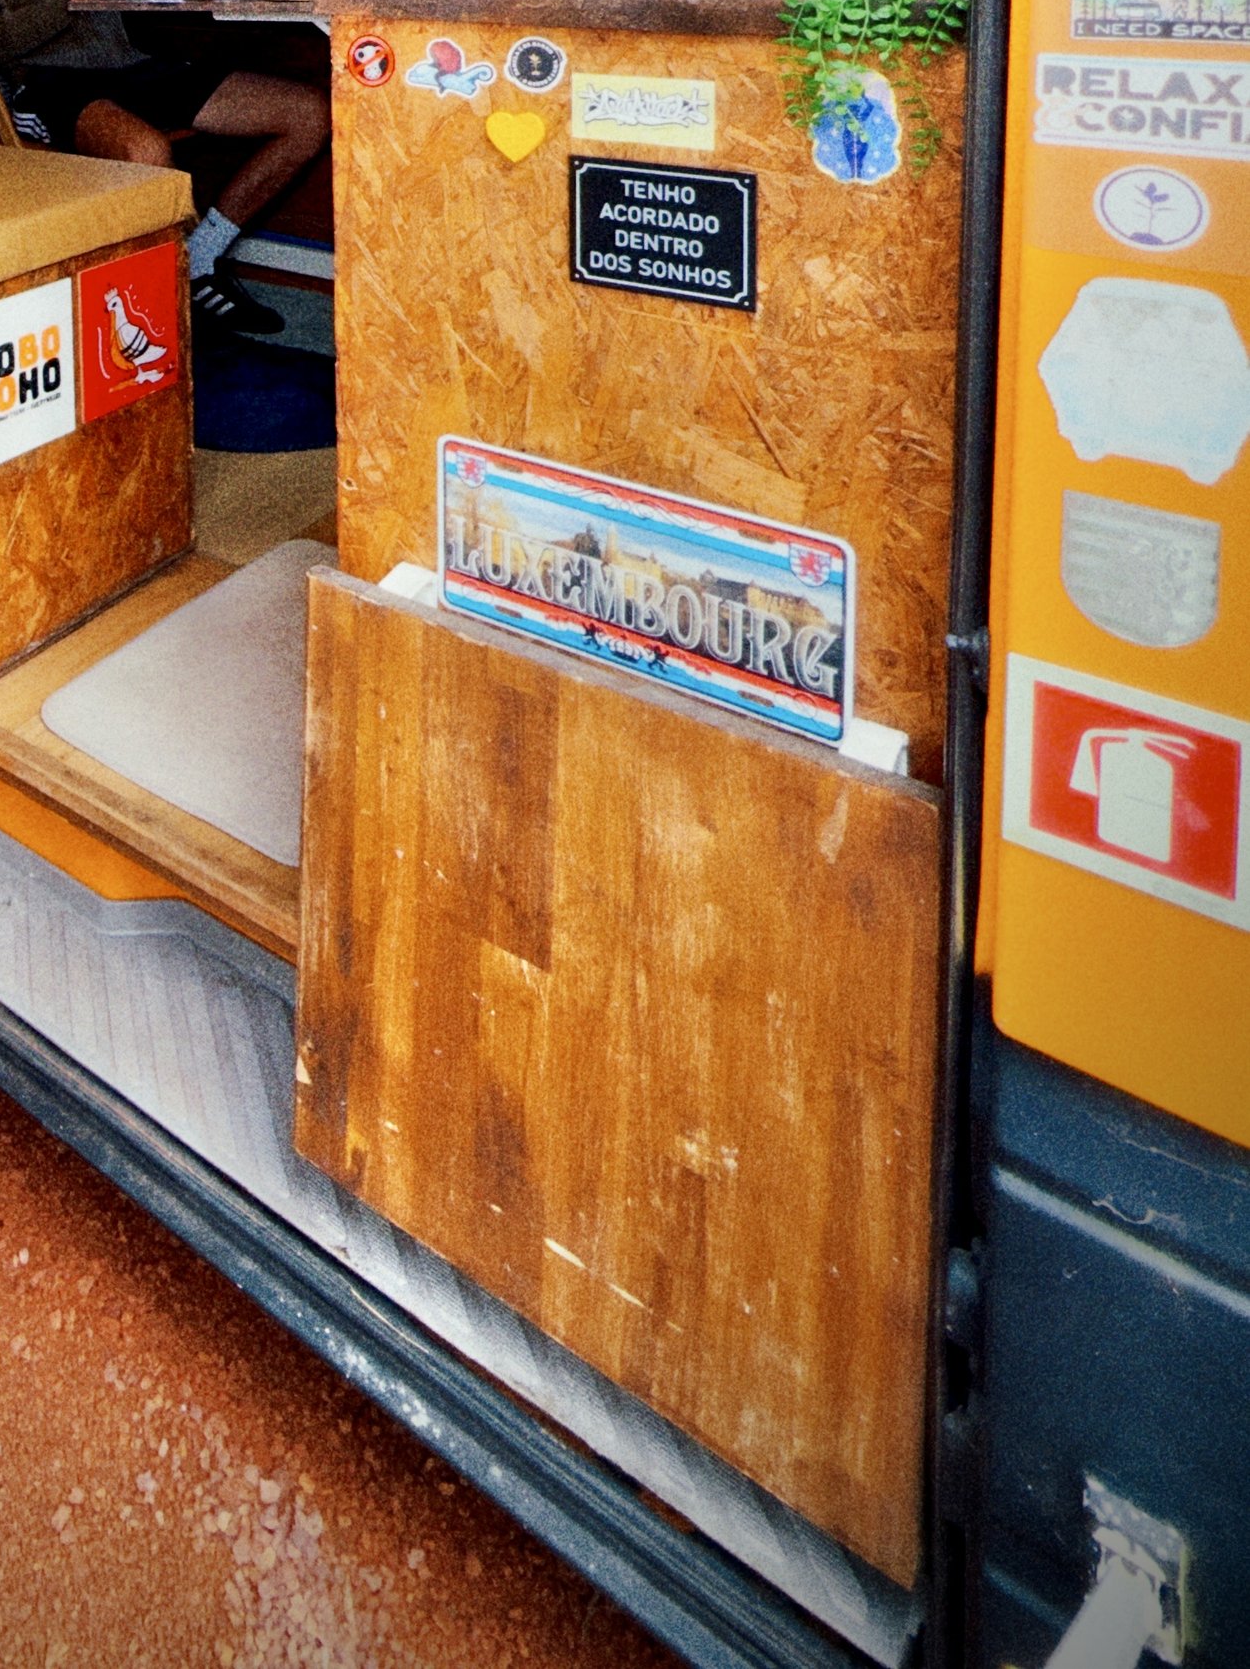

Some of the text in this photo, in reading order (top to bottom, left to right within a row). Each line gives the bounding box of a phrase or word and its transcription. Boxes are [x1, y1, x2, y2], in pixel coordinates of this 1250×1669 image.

[1076, 22, 1086, 35] I
[1094, 22, 1162, 37] NEED
[1042, 64, 1250, 108] RELAX
[1074, 101, 1250, 145] CONFI
[620, 178, 696, 205] TENHO
[599, 202, 720, 234] ACORDADO
[614, 229, 704, 258] DENTRO
[589, 250, 732, 289] DOS SONHOS
[448, 514, 840, 698] LUXEMBOURG
